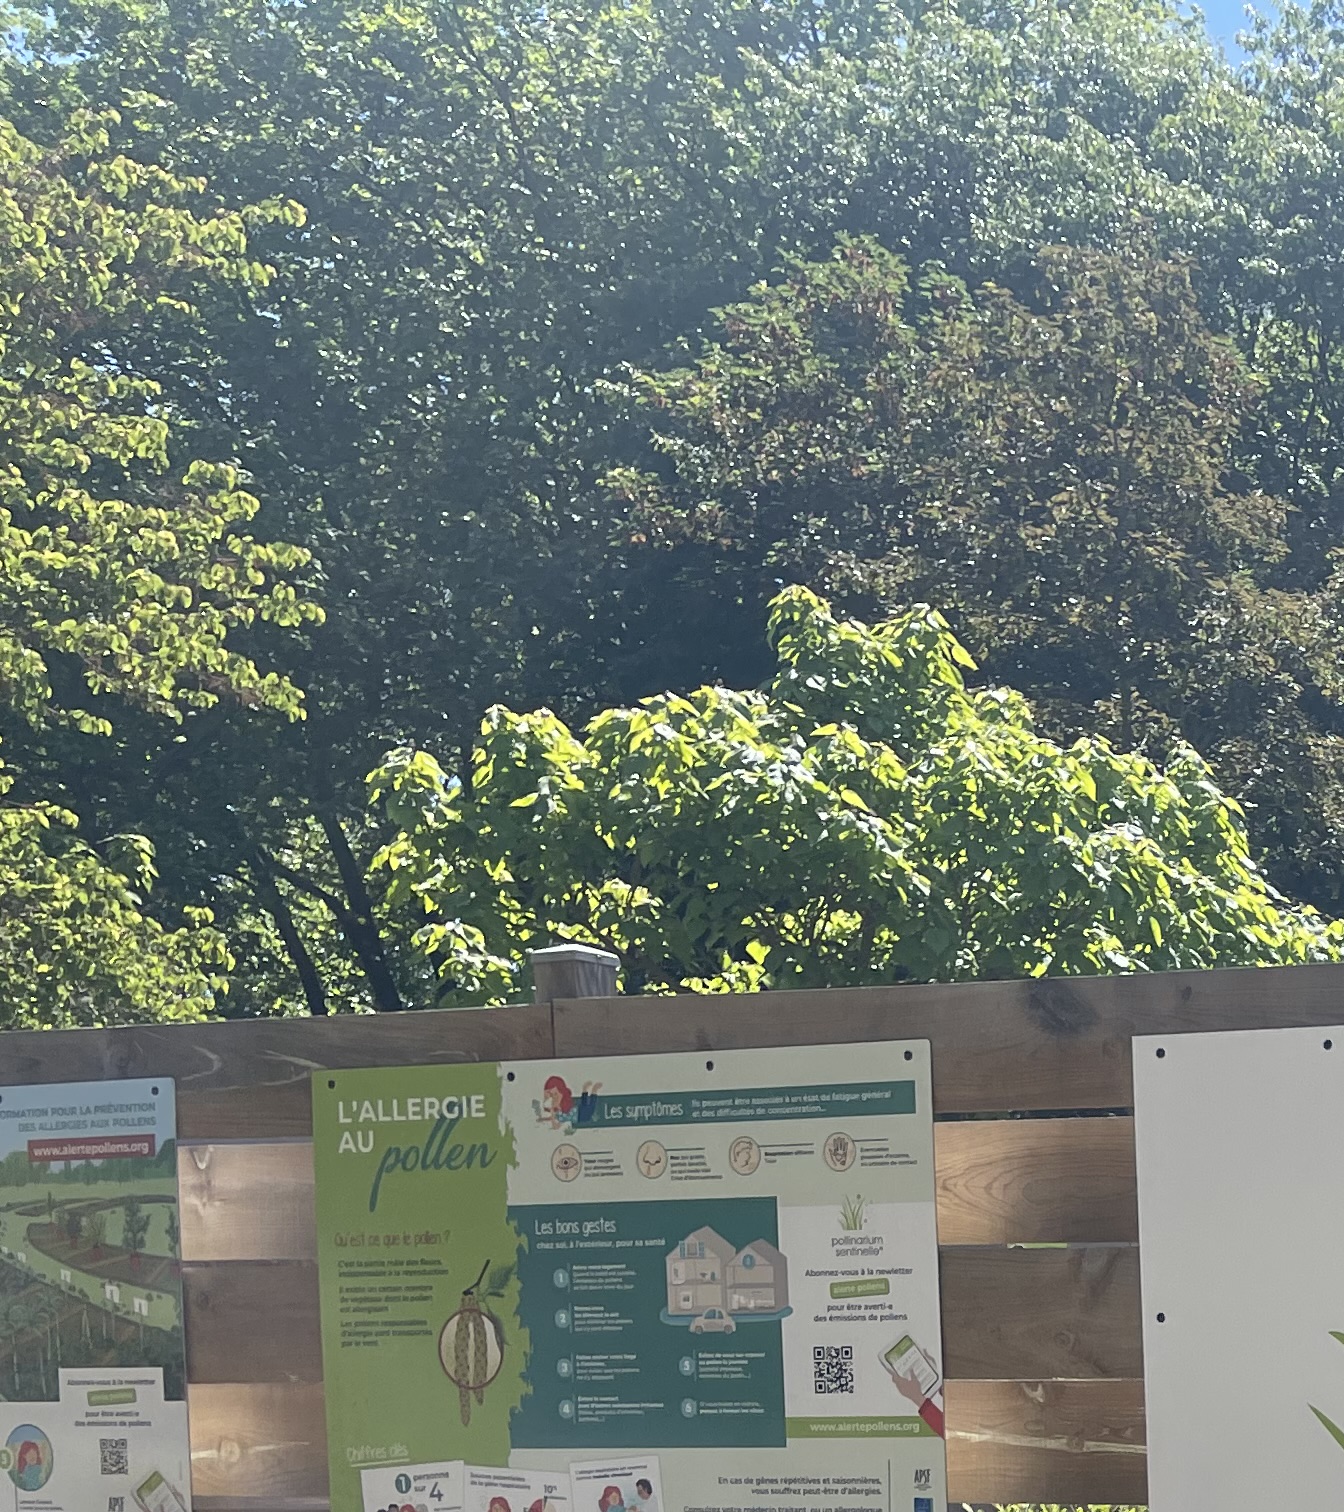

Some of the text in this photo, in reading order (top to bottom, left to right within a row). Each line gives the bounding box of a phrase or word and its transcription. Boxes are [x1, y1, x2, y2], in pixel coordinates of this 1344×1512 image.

[51, 1106, 78, 1117] POUR
[80, 1105, 92, 1116] LA
[338, 1094, 486, 1124] L'ALLERGIE
[604, 1101, 684, 1121] Les symptômes
[18, 1122, 36, 1133] DES
[338, 1130, 374, 1154] AU
[368, 1100, 498, 1213] pollen
[535, 1217, 616, 1237] Les bons gestes
[831, 1236, 884, 1247] pollinarium
[810, 1422, 920, 1434] www.alertepollens.org
[718, 1477, 728, 1485] En
[744, 1477, 754, 1485] de
[429, 1481, 444, 1502] 4
